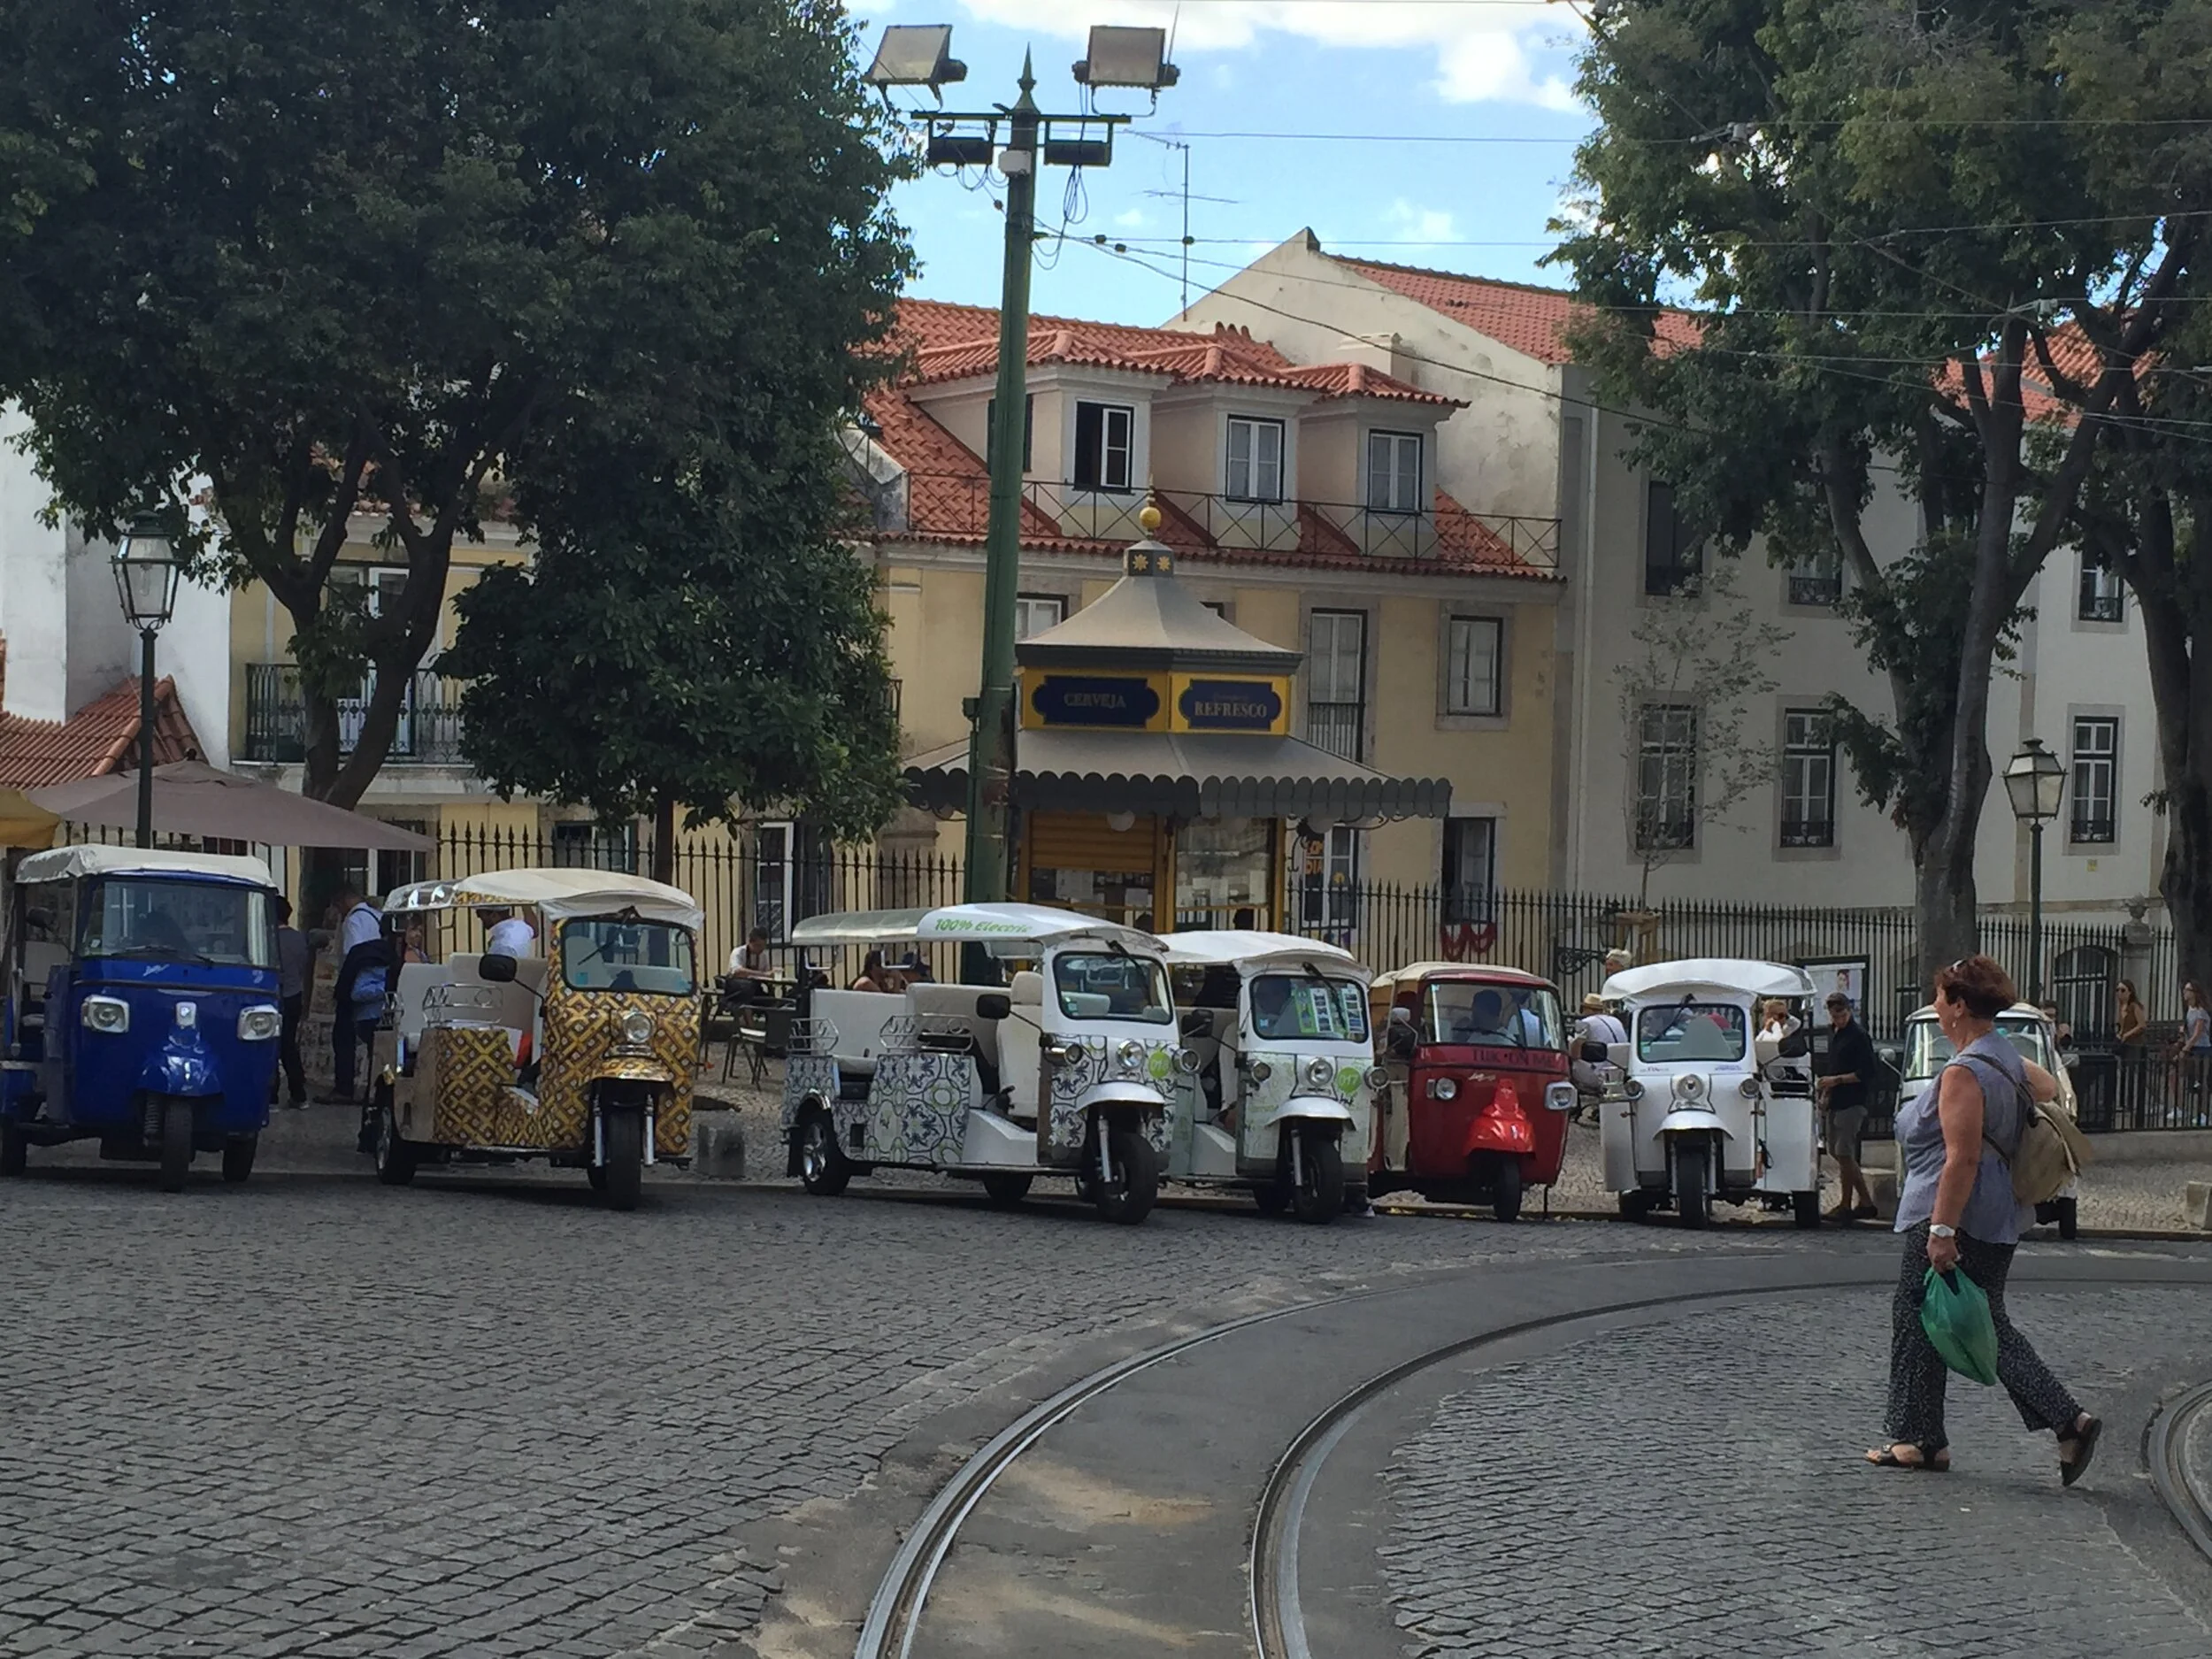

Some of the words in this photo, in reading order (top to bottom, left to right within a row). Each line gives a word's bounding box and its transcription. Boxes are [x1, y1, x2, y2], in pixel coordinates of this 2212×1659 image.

[1064, 693, 1126, 709] CERVEJA
[1194, 701, 1267, 718] REFRESCO
[935, 918, 972, 931] 100%
[974, 921, 1033, 933] Electric
